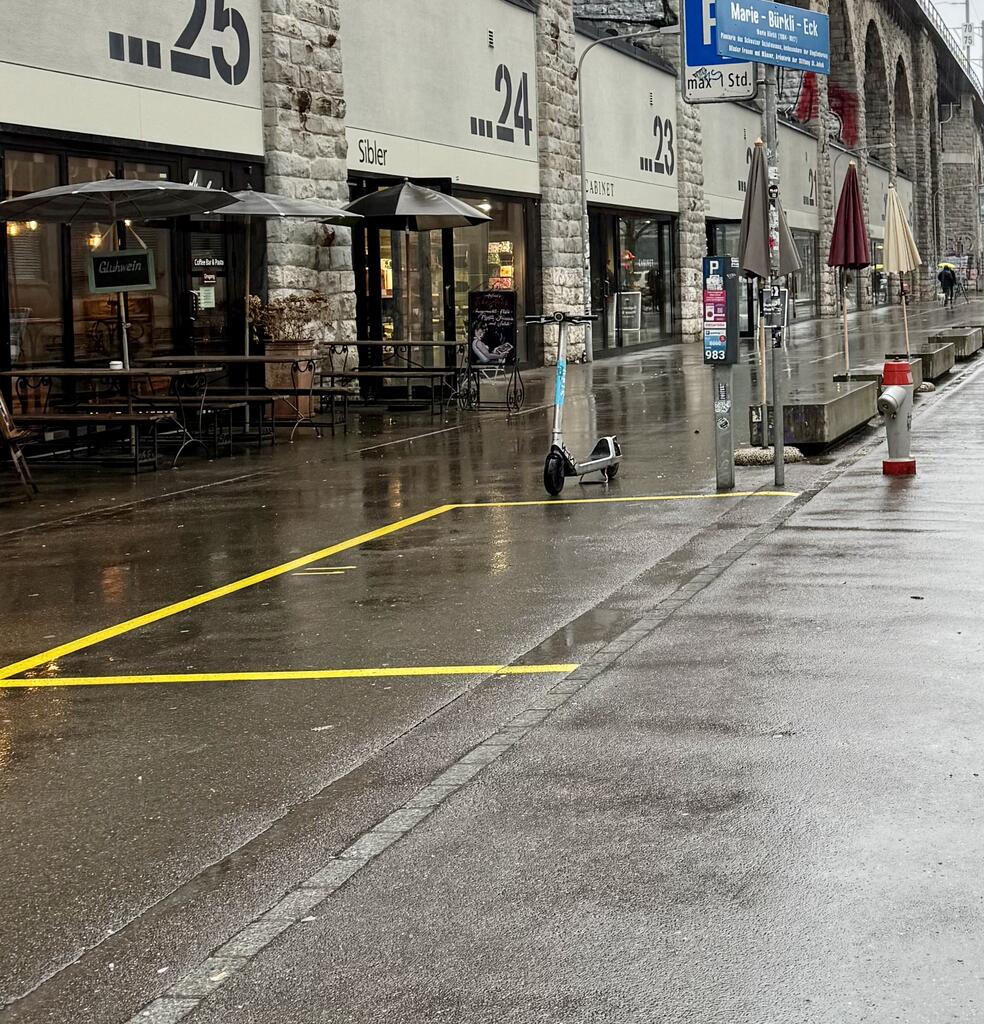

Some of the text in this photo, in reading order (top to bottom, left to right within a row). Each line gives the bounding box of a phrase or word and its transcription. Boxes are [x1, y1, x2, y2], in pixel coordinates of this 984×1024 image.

[730, 1, 759, 23] Marie
[768, 10, 795, 32] Bürkli
[803, 18, 818, 37] Eck
[687, 76, 712, 90] max
[728, 71, 752, 87] Std.
[358, 139, 389, 168] Sibler
[709, 261, 719, 274] P
[705, 350, 725, 360] 983
